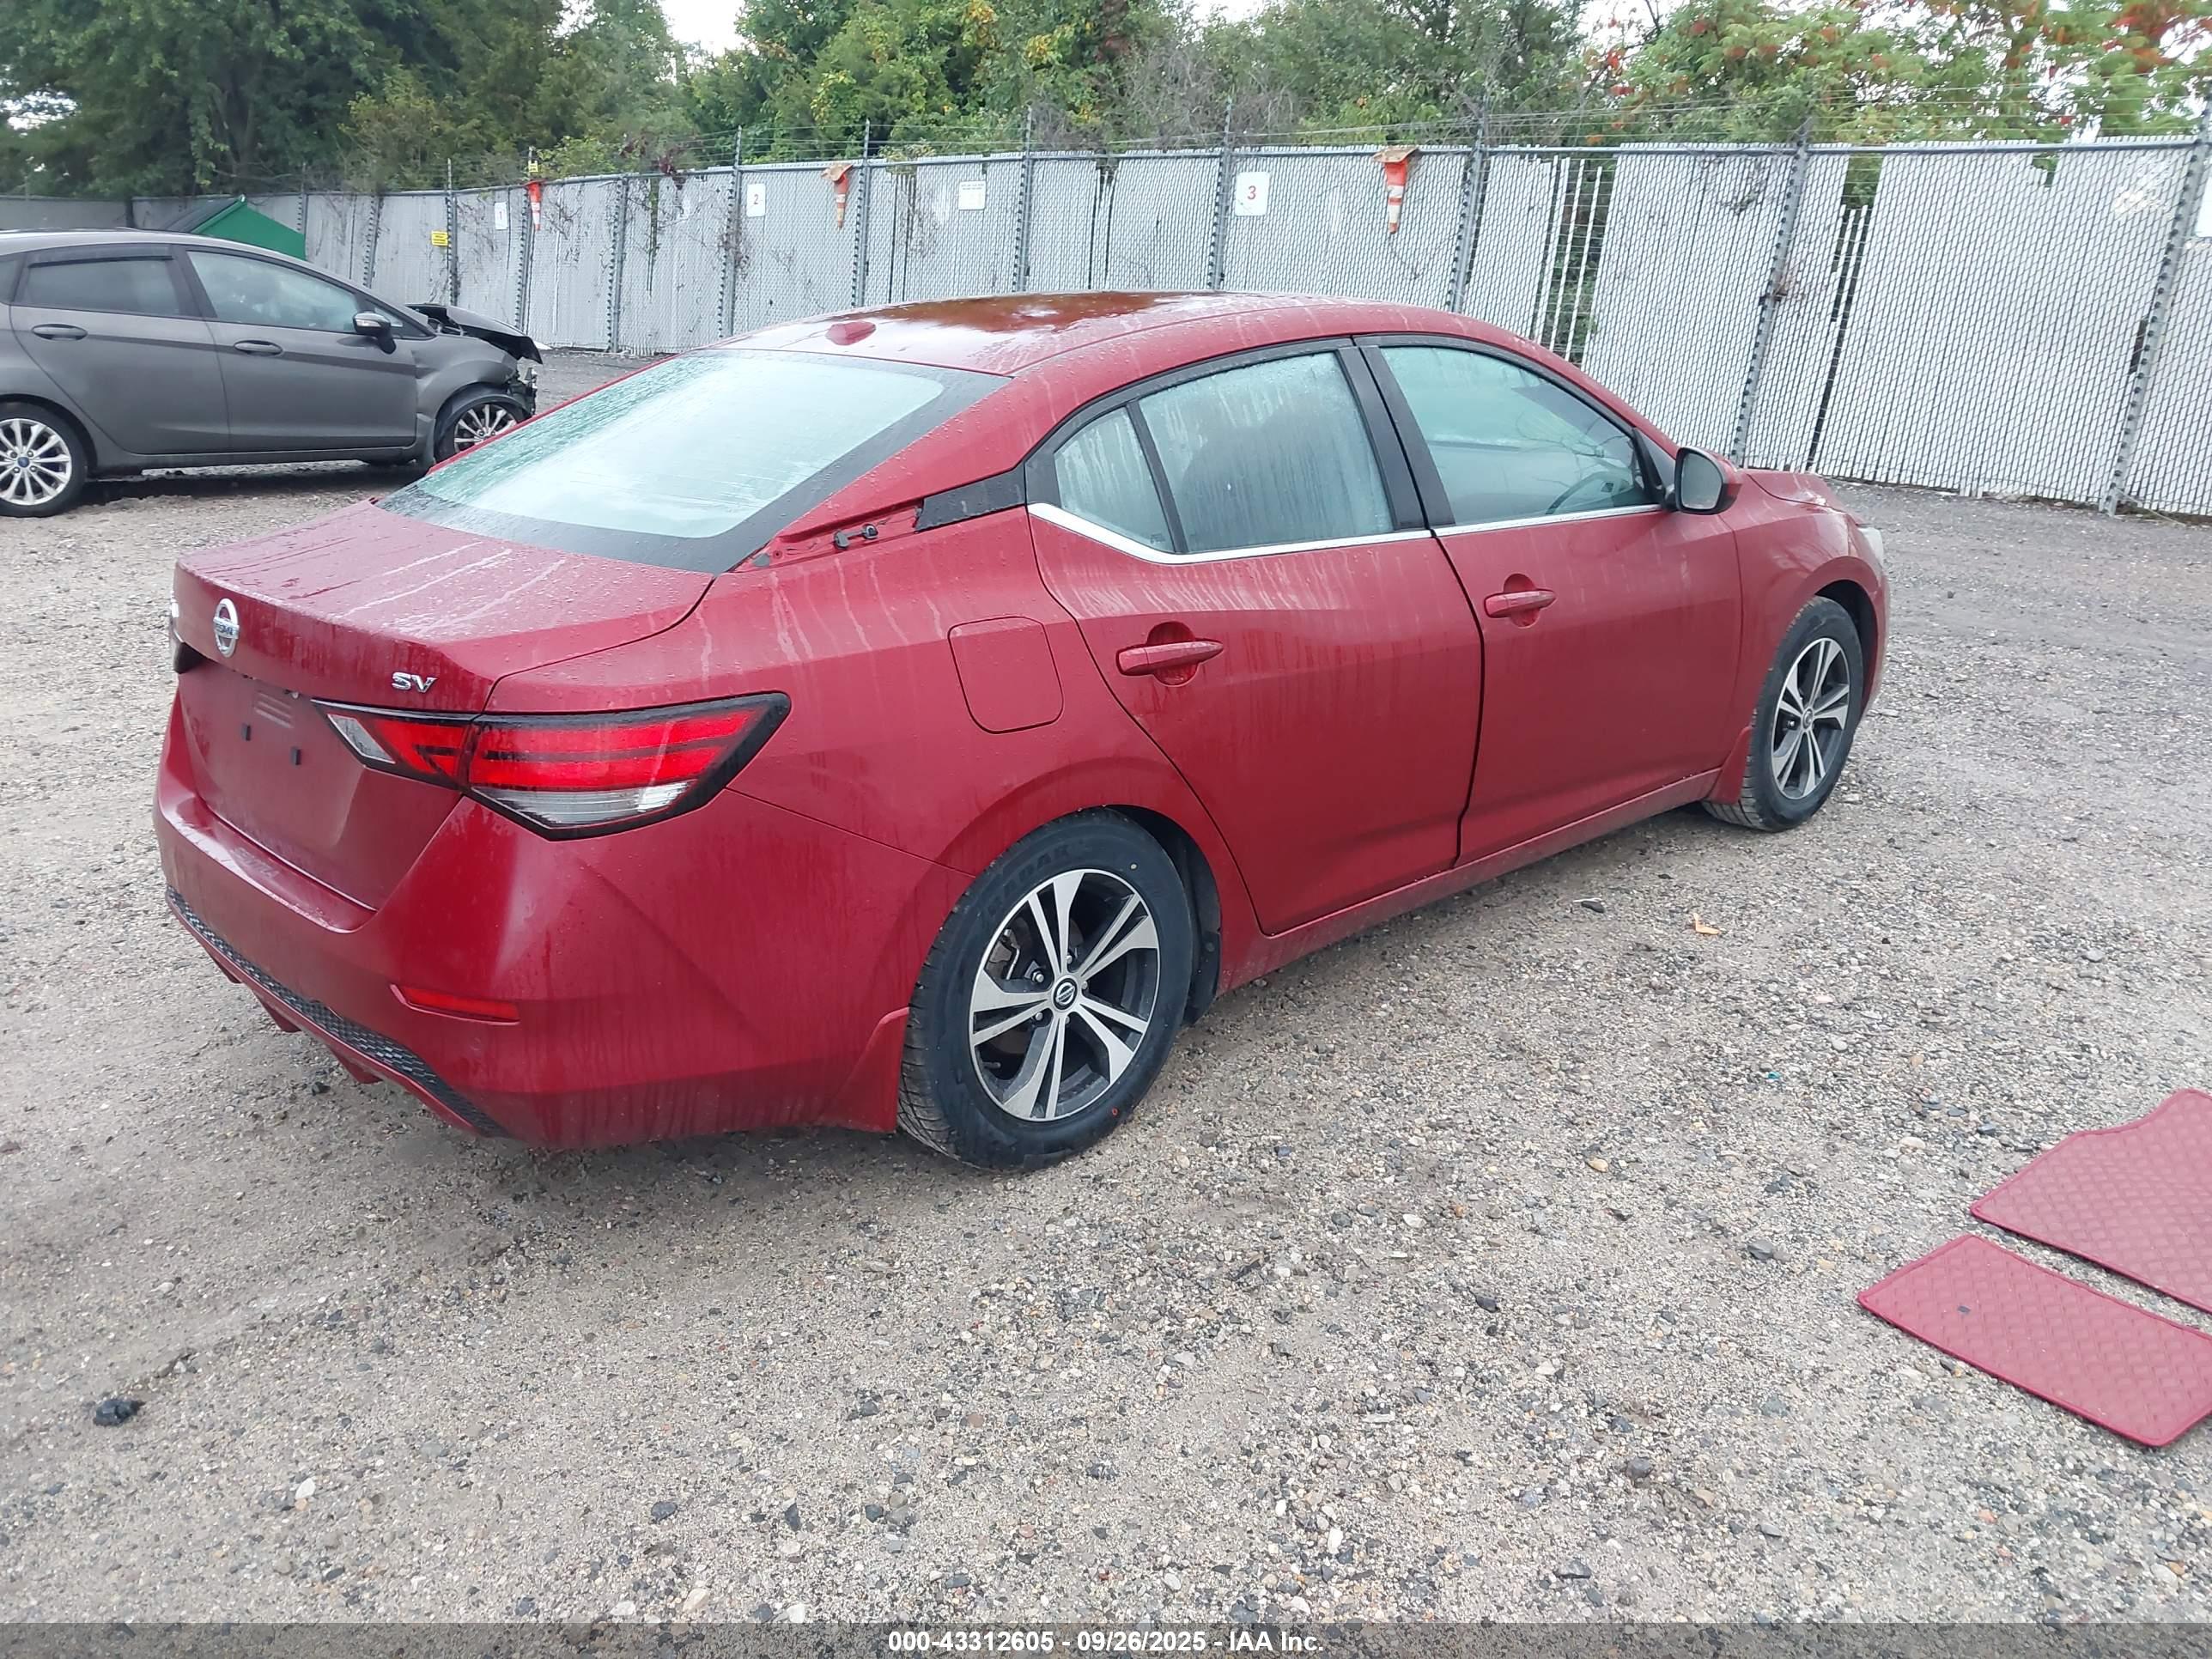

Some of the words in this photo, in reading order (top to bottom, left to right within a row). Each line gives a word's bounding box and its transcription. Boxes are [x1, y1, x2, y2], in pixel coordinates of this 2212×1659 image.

[752, 193, 760, 205] 2
[1247, 185, 1257, 200] 3
[392, 672, 439, 693] SV
